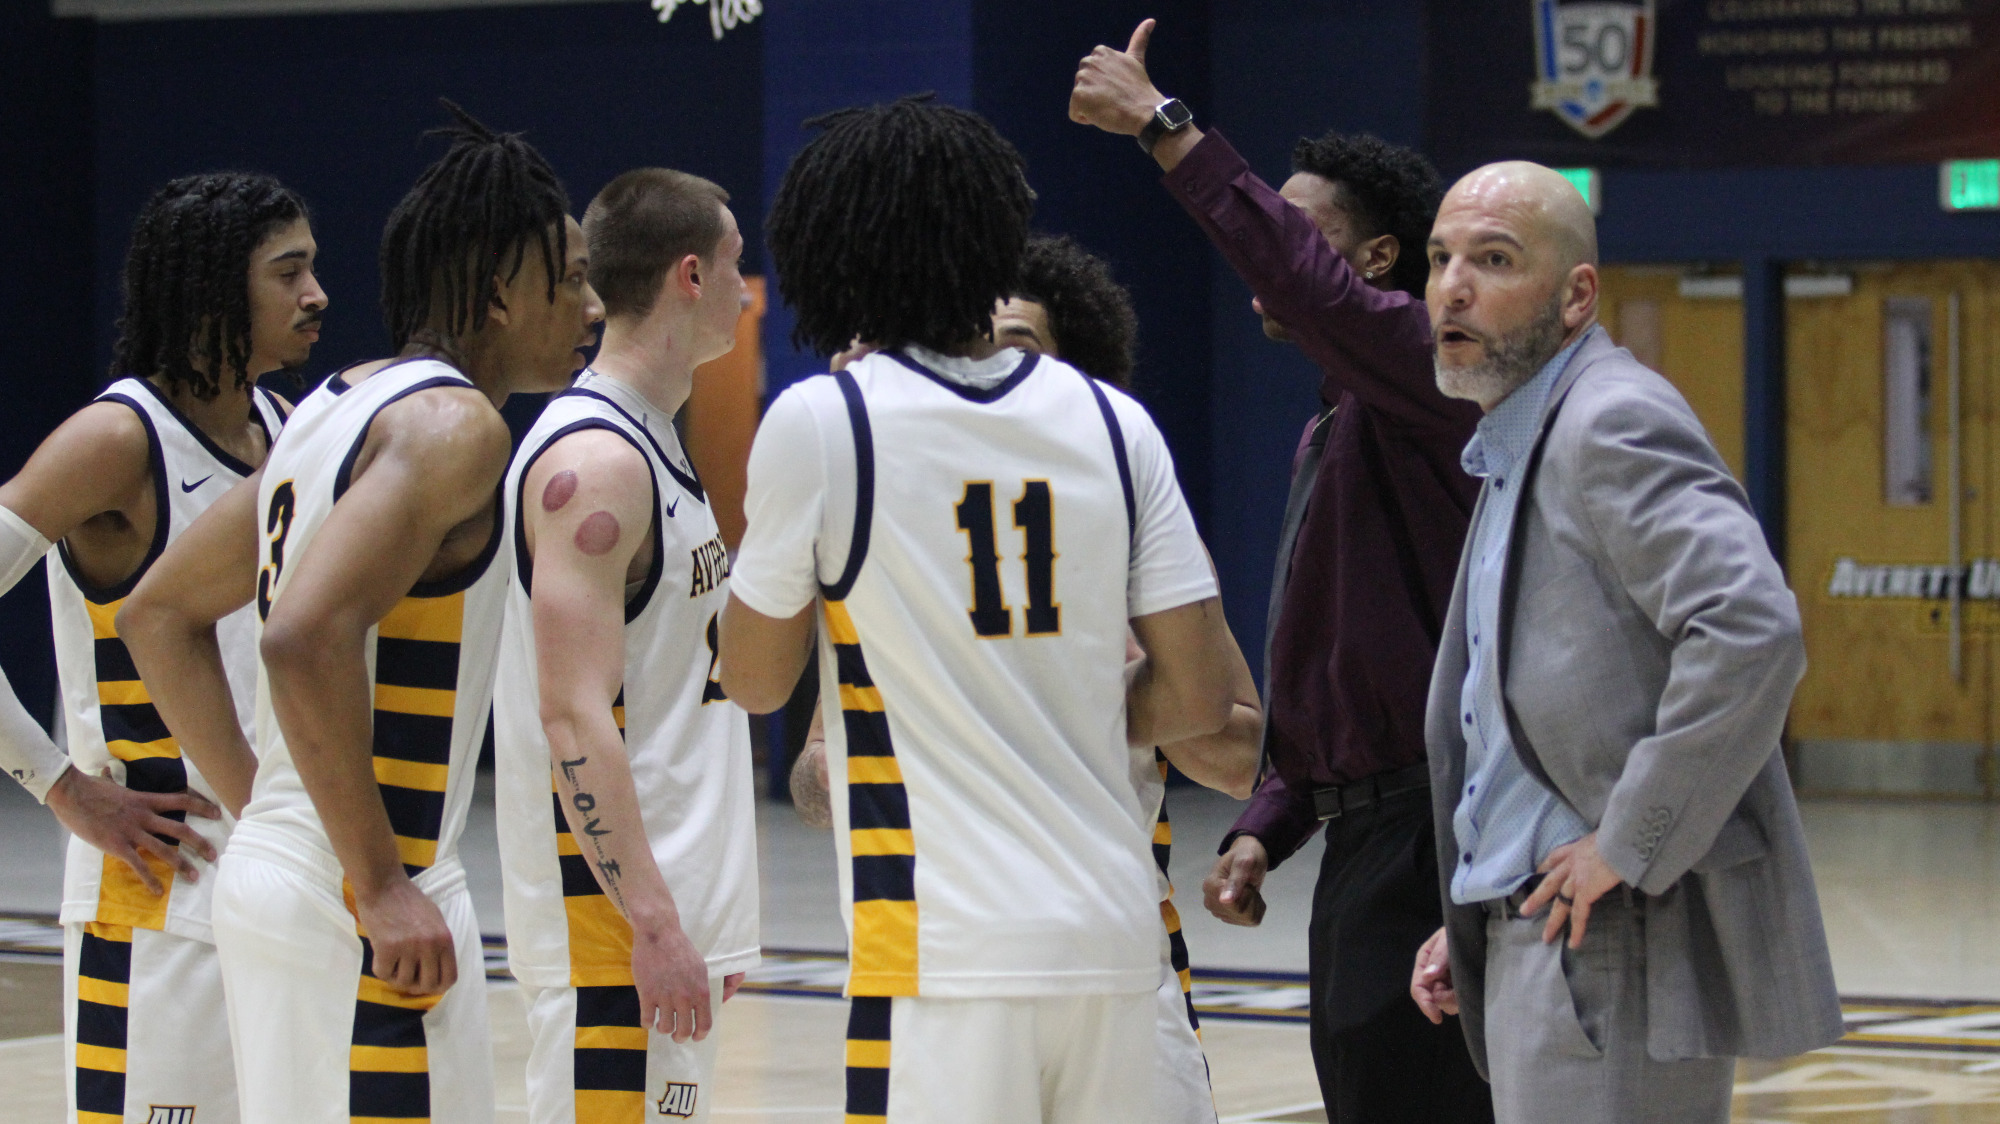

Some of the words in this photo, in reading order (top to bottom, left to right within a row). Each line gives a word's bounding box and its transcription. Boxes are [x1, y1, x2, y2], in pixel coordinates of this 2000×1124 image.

[1562, 23, 1627, 74] 50
[952, 478, 1062, 640] 11
[658, 1082, 698, 1119] AU
